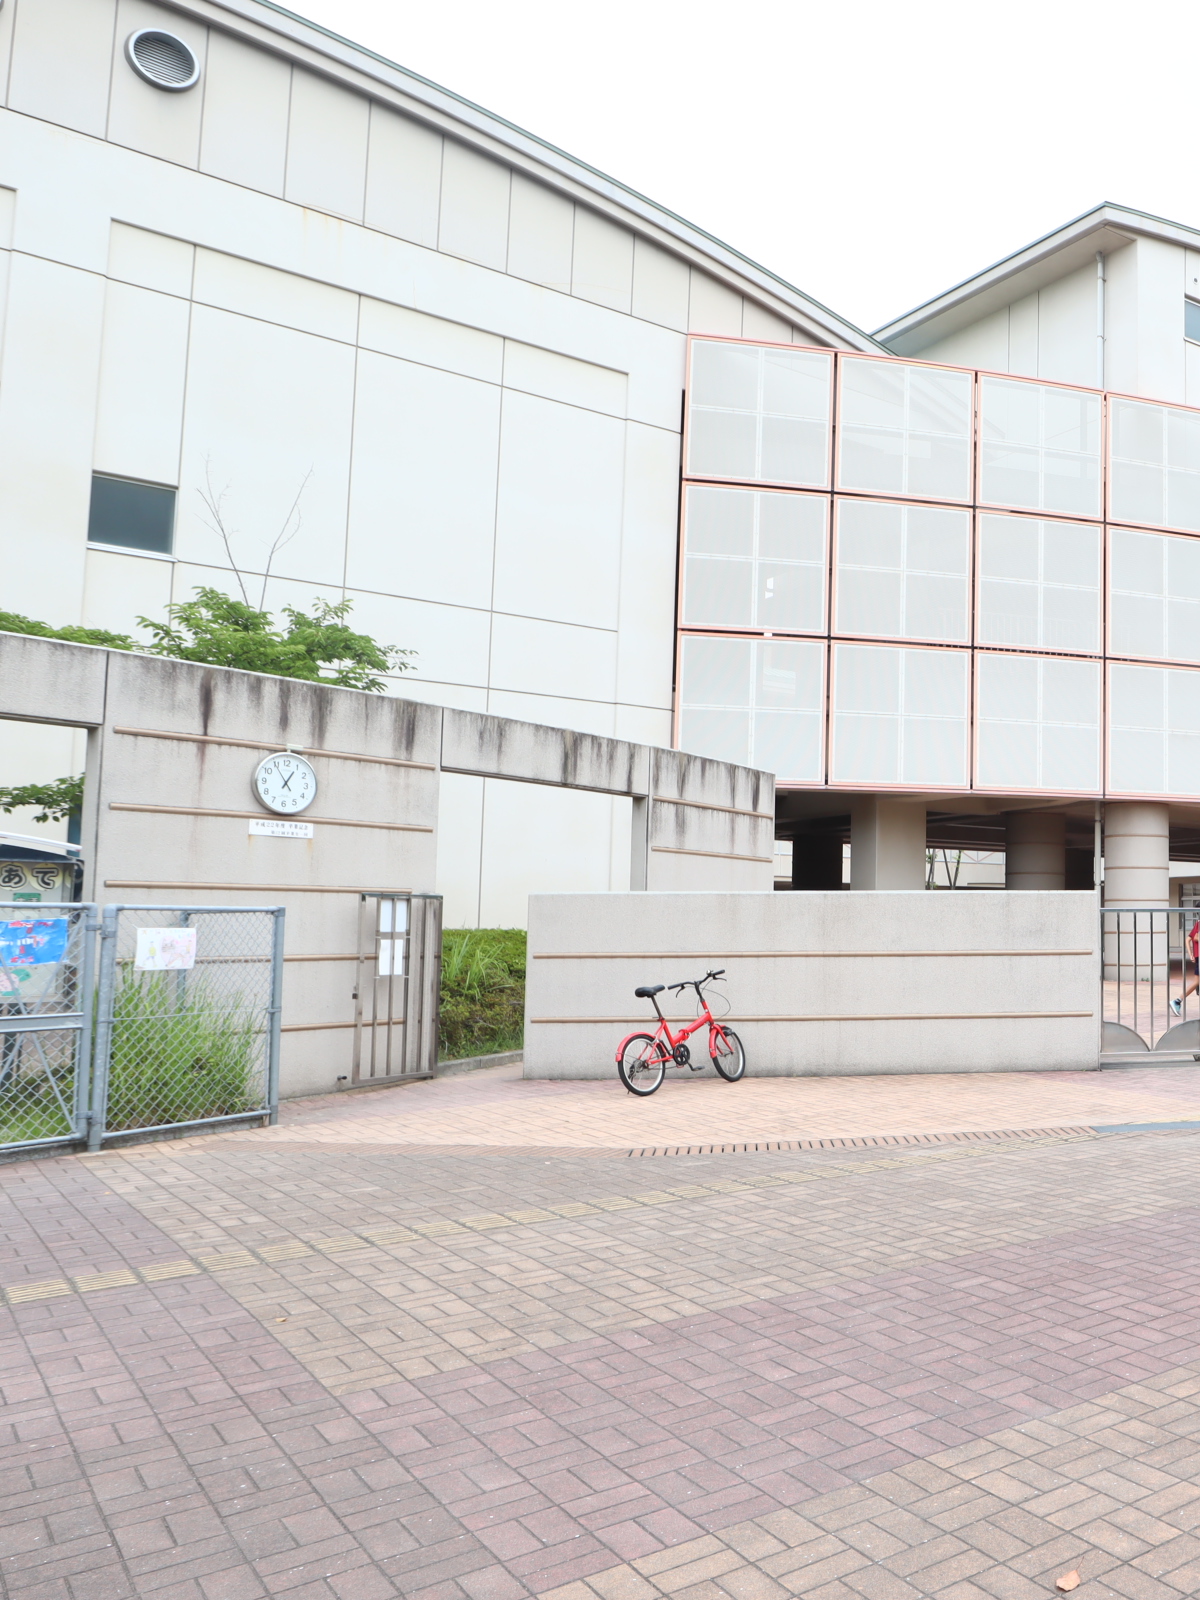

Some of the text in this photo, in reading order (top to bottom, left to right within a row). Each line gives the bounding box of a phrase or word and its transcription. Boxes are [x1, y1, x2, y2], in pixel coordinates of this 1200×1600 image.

[264, 767, 272, 775] 10
[301, 772, 307, 780] 2
[261, 777, 267, 785] 9
[303, 782, 309, 790] 3
[281, 800, 287, 808] 6
